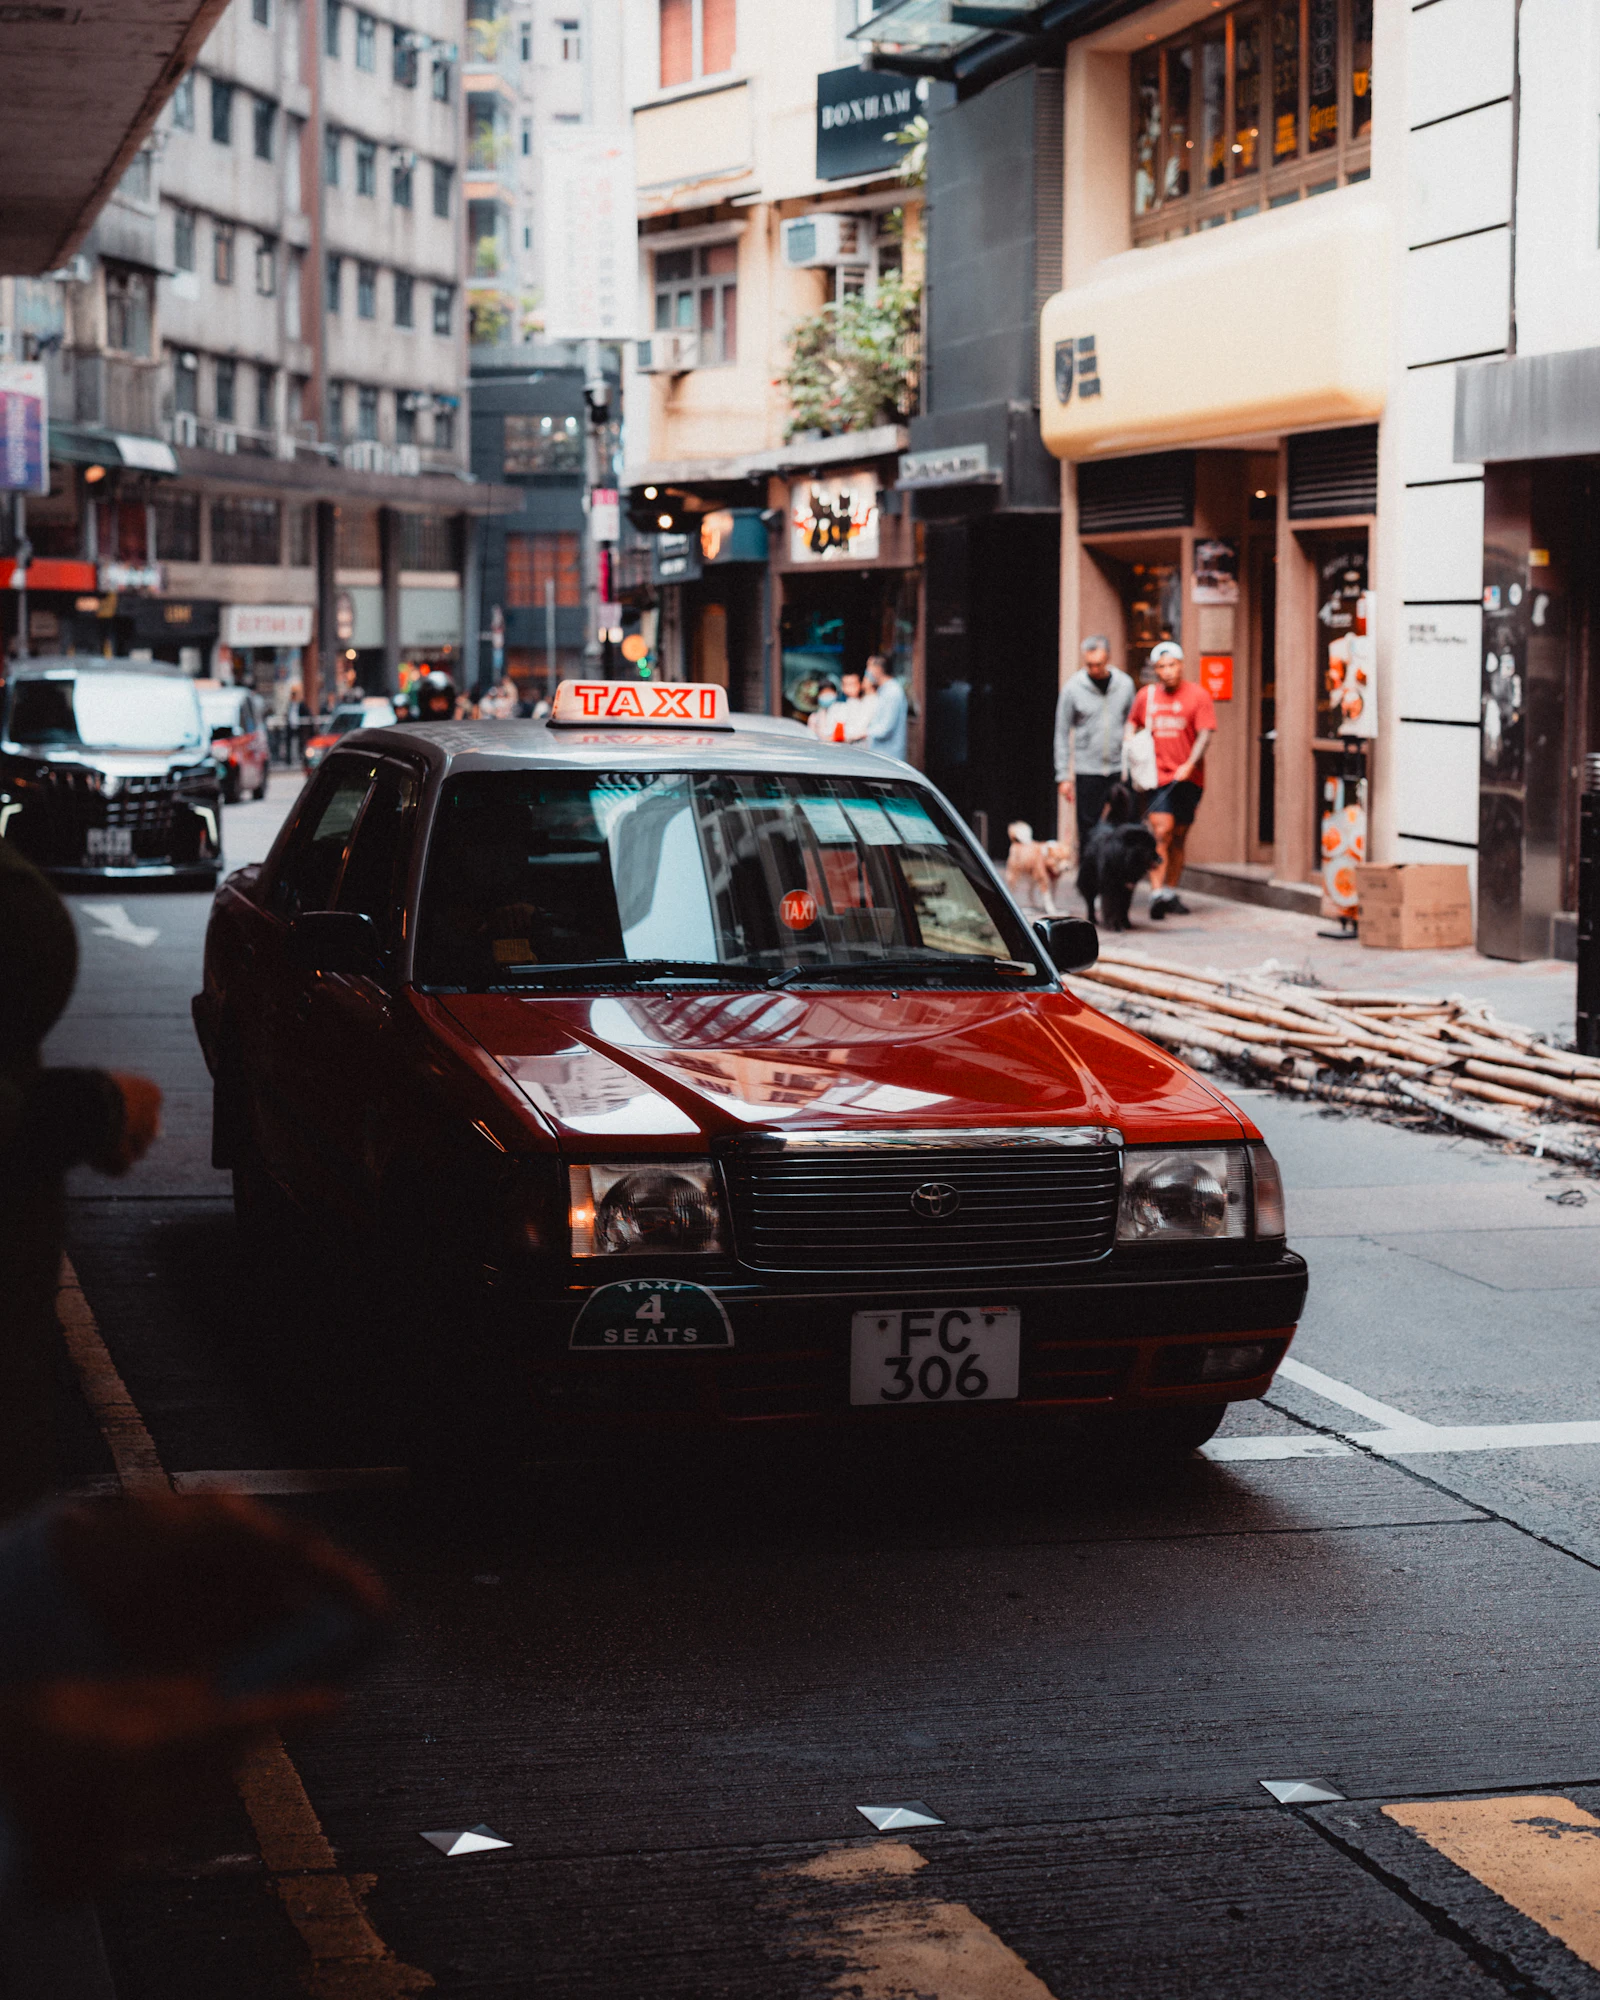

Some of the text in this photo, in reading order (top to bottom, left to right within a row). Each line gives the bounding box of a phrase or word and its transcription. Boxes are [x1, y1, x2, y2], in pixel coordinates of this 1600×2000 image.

[574, 685, 716, 719] TAXI
[782, 900, 815, 921] TAXI
[618, 1281, 683, 1294] TAXI
[635, 1294, 666, 1325] 4
[603, 1327, 698, 1343] SEATS
[900, 1310, 972, 1356] FC
[880, 1353, 989, 1402] 306
